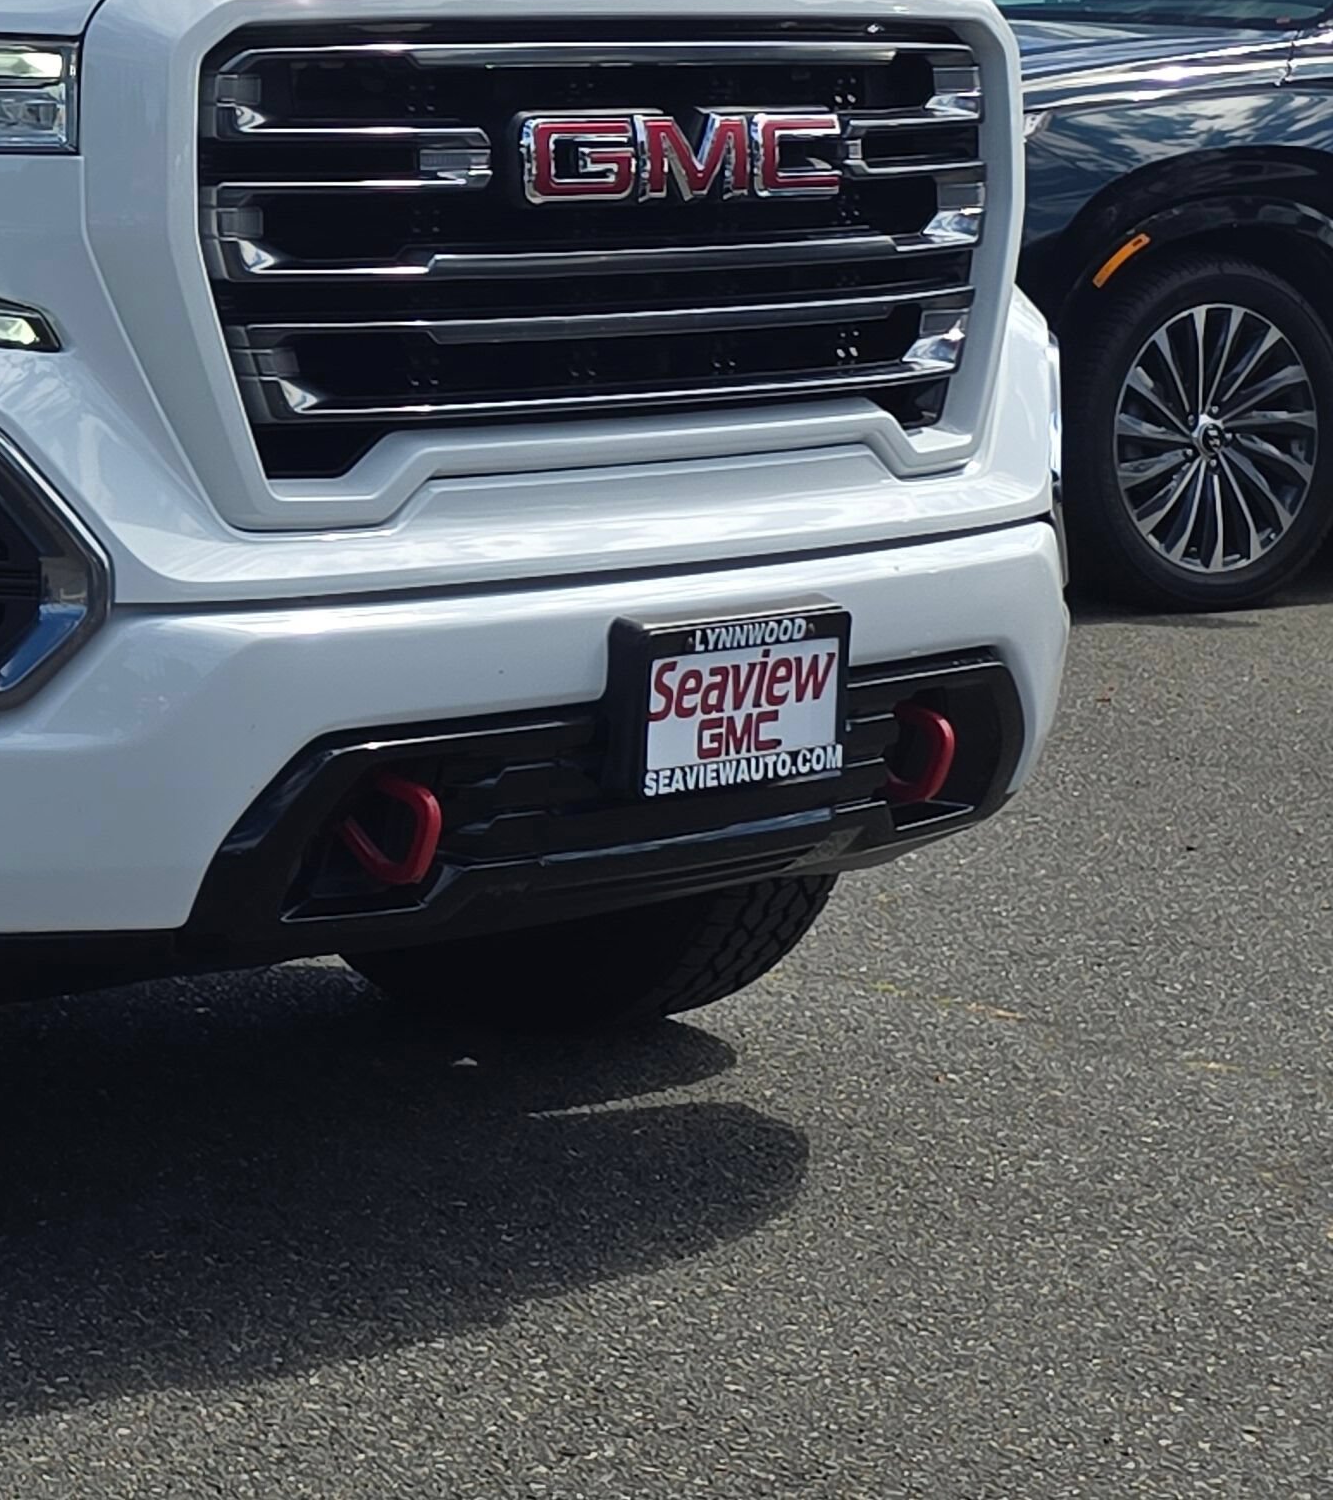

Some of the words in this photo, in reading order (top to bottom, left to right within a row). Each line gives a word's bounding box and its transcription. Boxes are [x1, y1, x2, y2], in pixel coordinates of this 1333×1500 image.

[521, 112, 841, 203] GMC
[695, 618, 807, 652] LYNNWOOD
[646, 648, 837, 722] Seaview
[697, 709, 782, 760] GMC
[643, 743, 844, 797] SEAVIEWAUTO.COM
